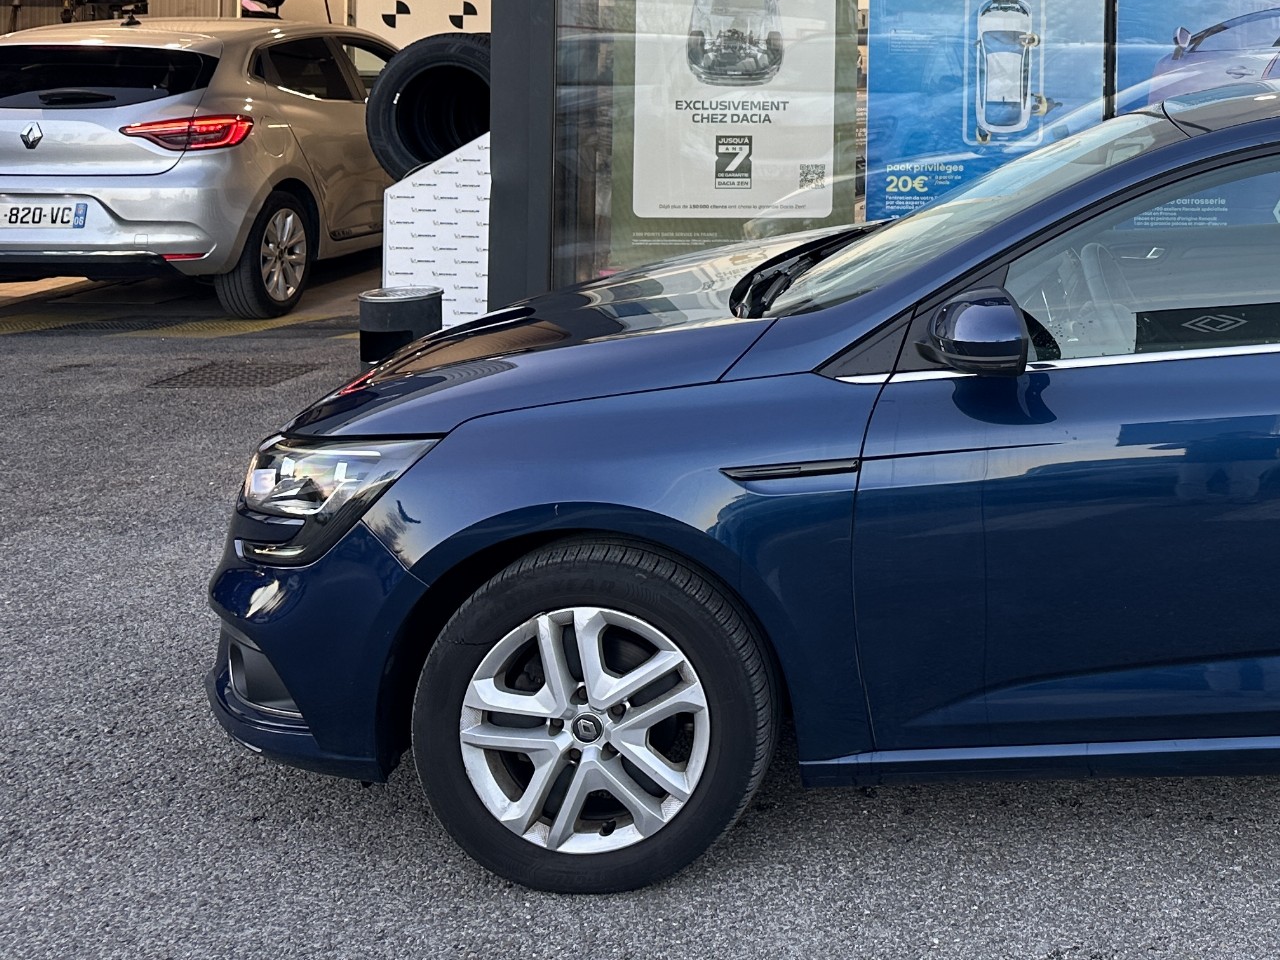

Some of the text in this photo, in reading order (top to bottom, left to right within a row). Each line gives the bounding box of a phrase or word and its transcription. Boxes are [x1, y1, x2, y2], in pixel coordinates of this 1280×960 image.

[675, 100, 790, 112] EXCLUSIVEMENT
[692, 113, 772, 124] CHEZ DACIA
[886, 162, 964, 173] pack privilèges
[1176, 197, 1226, 205] carrosserie
